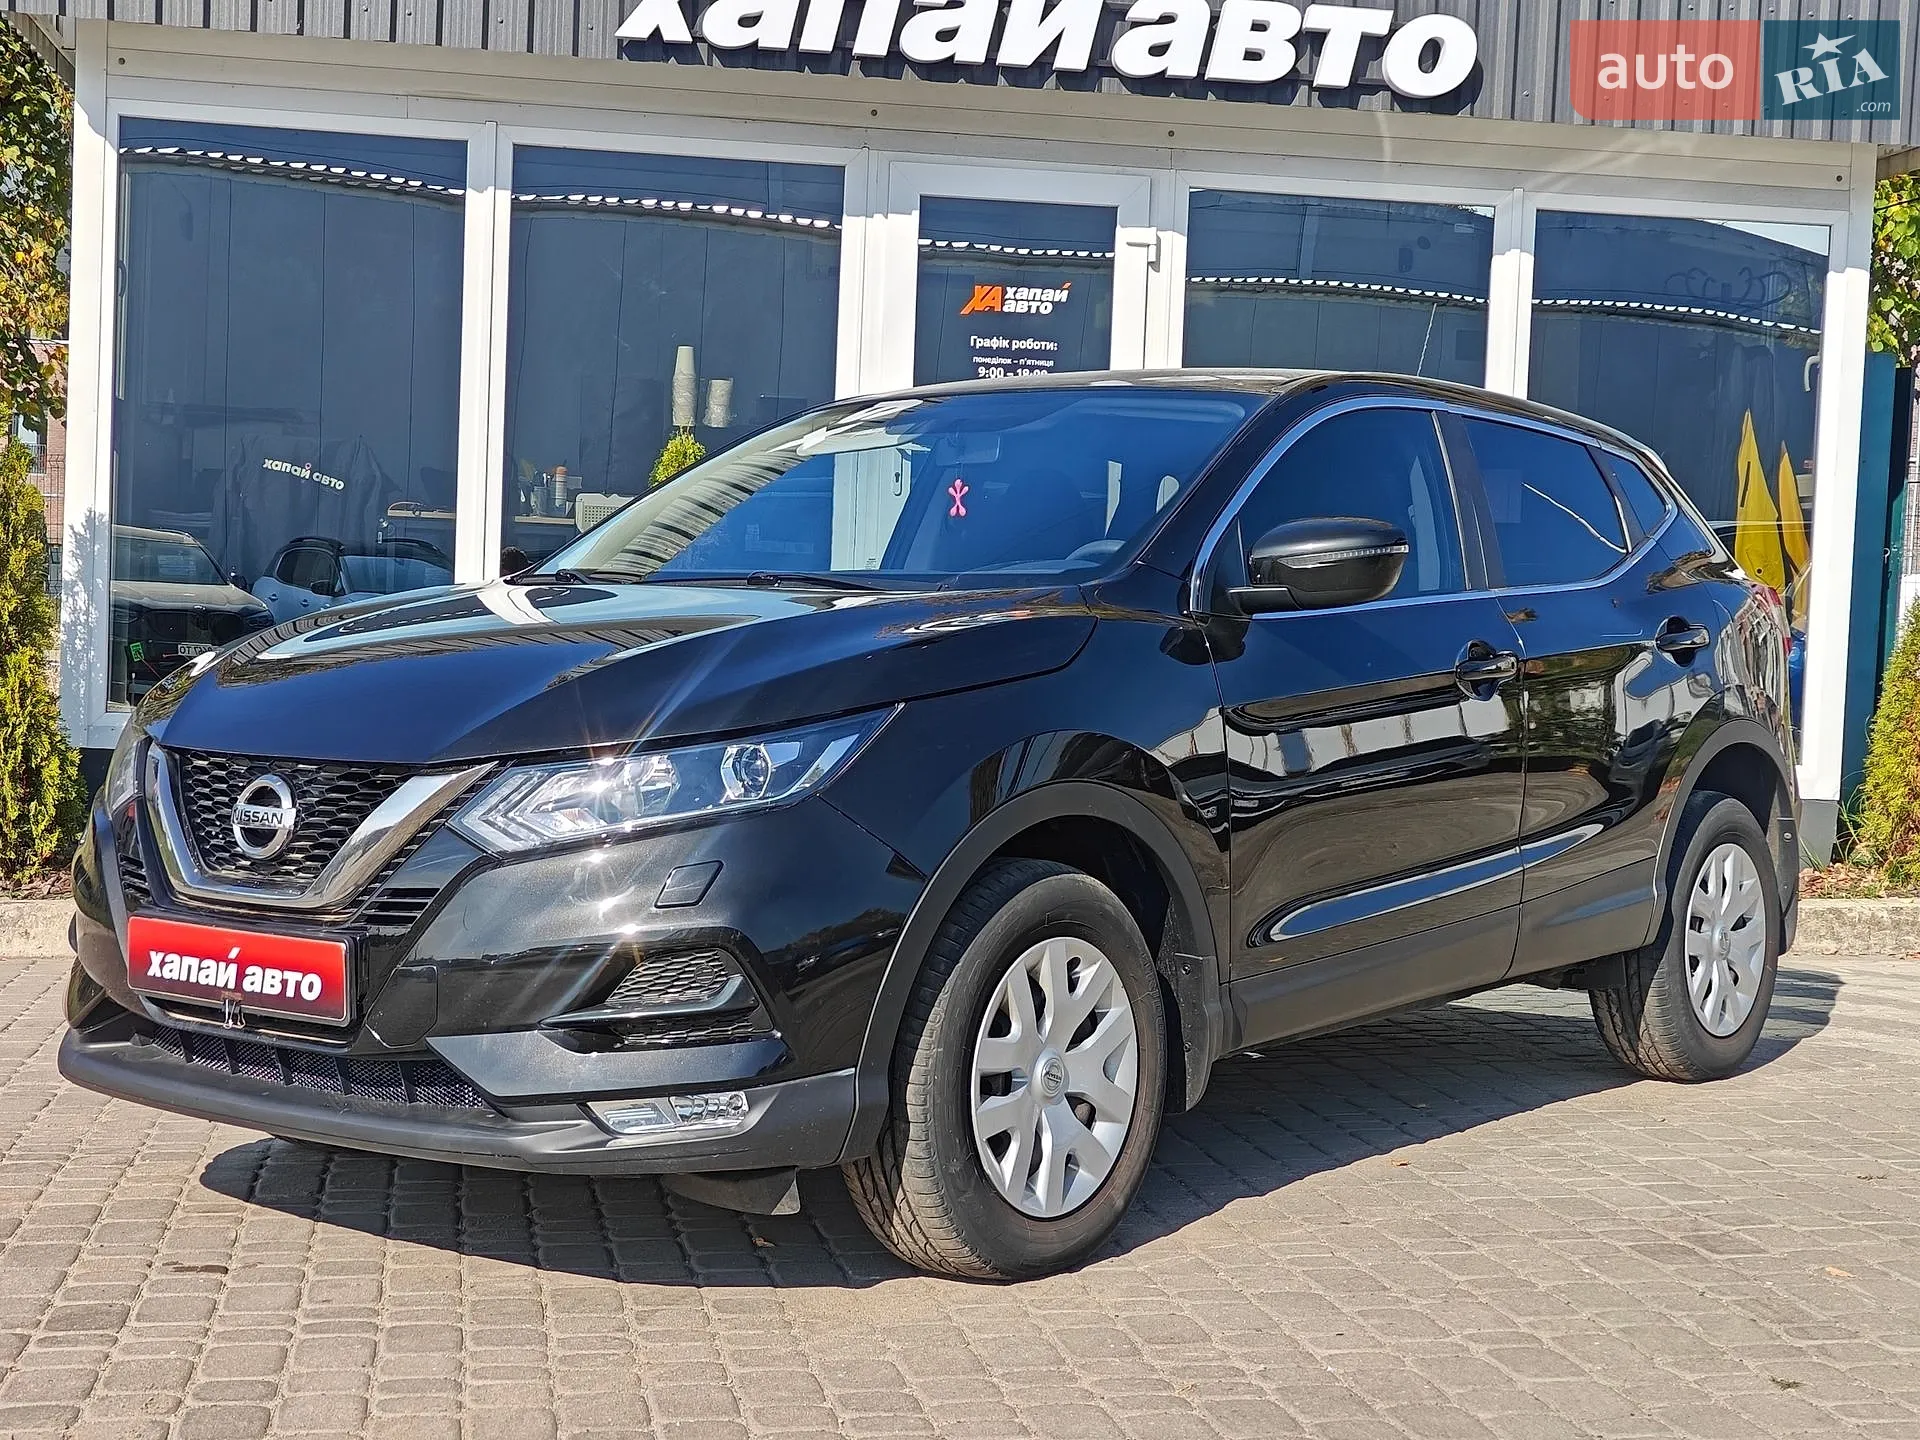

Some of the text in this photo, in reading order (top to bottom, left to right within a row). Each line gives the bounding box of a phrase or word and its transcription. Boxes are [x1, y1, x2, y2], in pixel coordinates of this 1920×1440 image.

[1112, 0, 1479, 98] авто
[1004, 282, 1072, 302] хапай
[1003, 300, 1053, 315] авто
[970, 335, 1058, 351] Графік роботи:
[972, 356, 1012, 365] понеділок
[978, 366, 1004, 379] 9:00
[262, 459, 344, 490] хапай авто
[233, 807, 283, 825] NISSAN
[147, 947, 322, 1000] хапай авто
